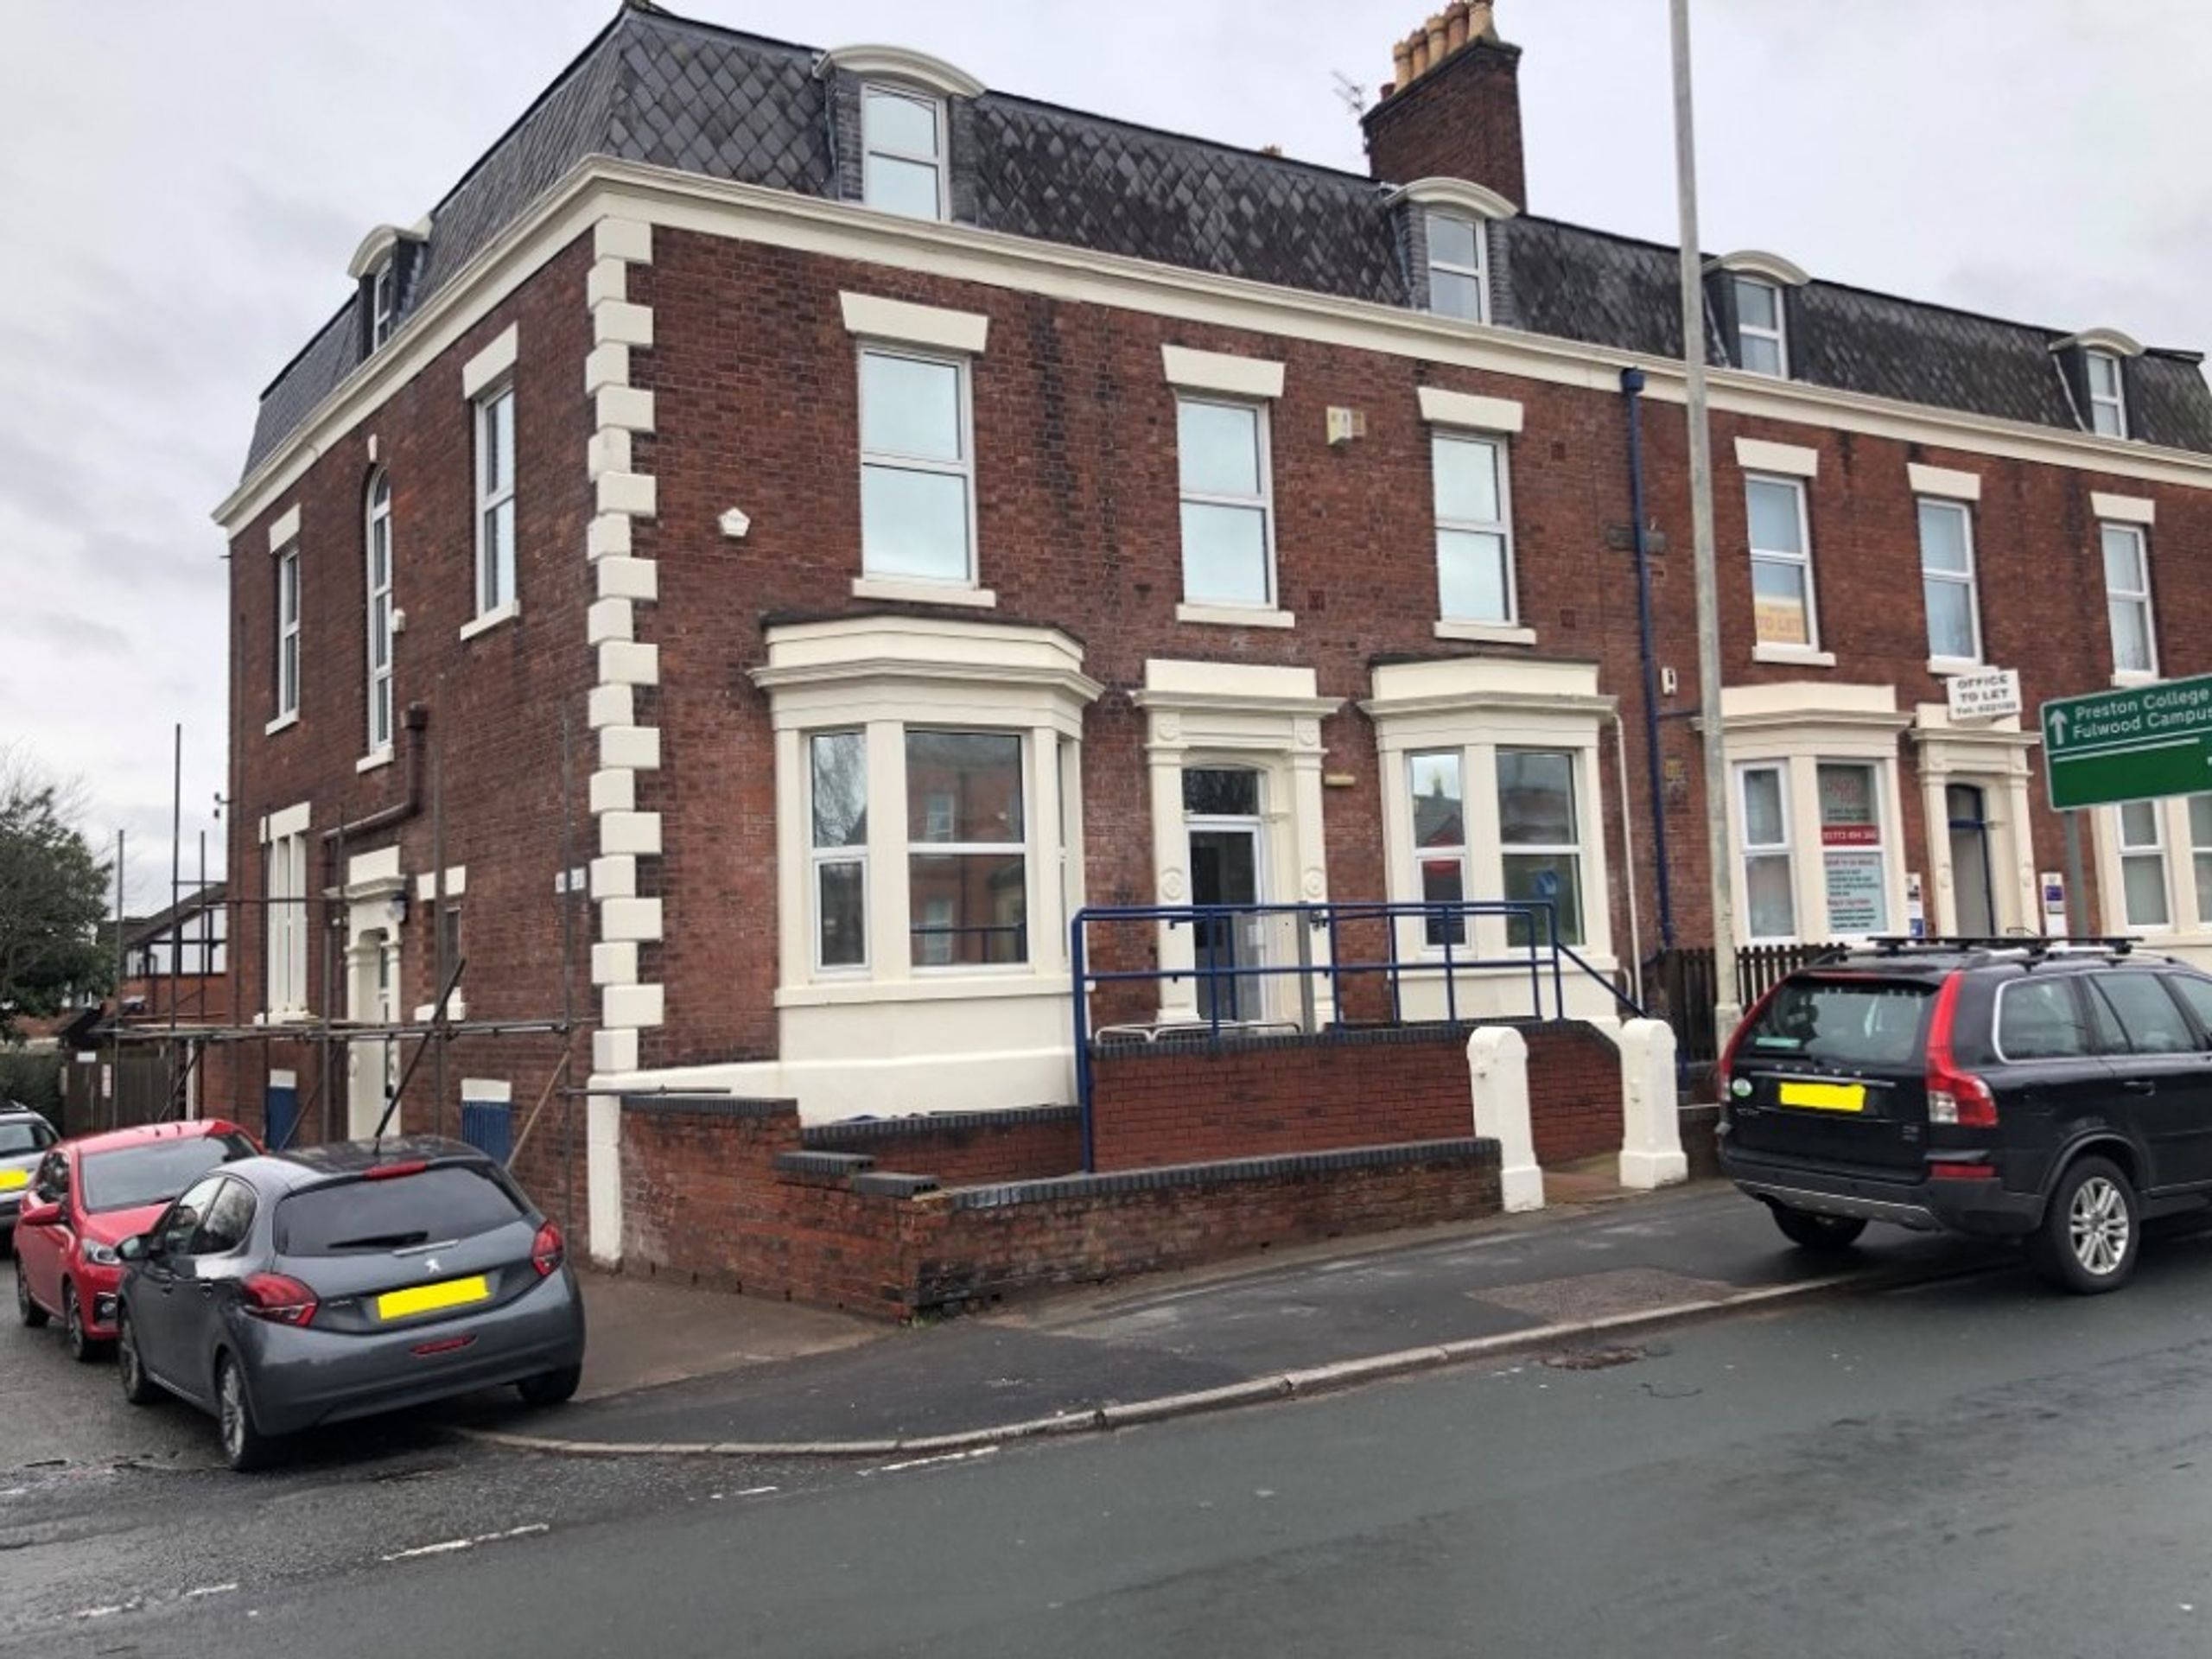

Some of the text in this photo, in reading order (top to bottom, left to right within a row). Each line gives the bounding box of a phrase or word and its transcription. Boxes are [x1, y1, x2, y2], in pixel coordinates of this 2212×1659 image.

[1957, 675, 2007, 689] OFFICE
[1960, 689, 2008, 702] TO LET
[2075, 689, 2209, 721] Preston College
[2073, 707, 2212, 739] Fulwood Campus
